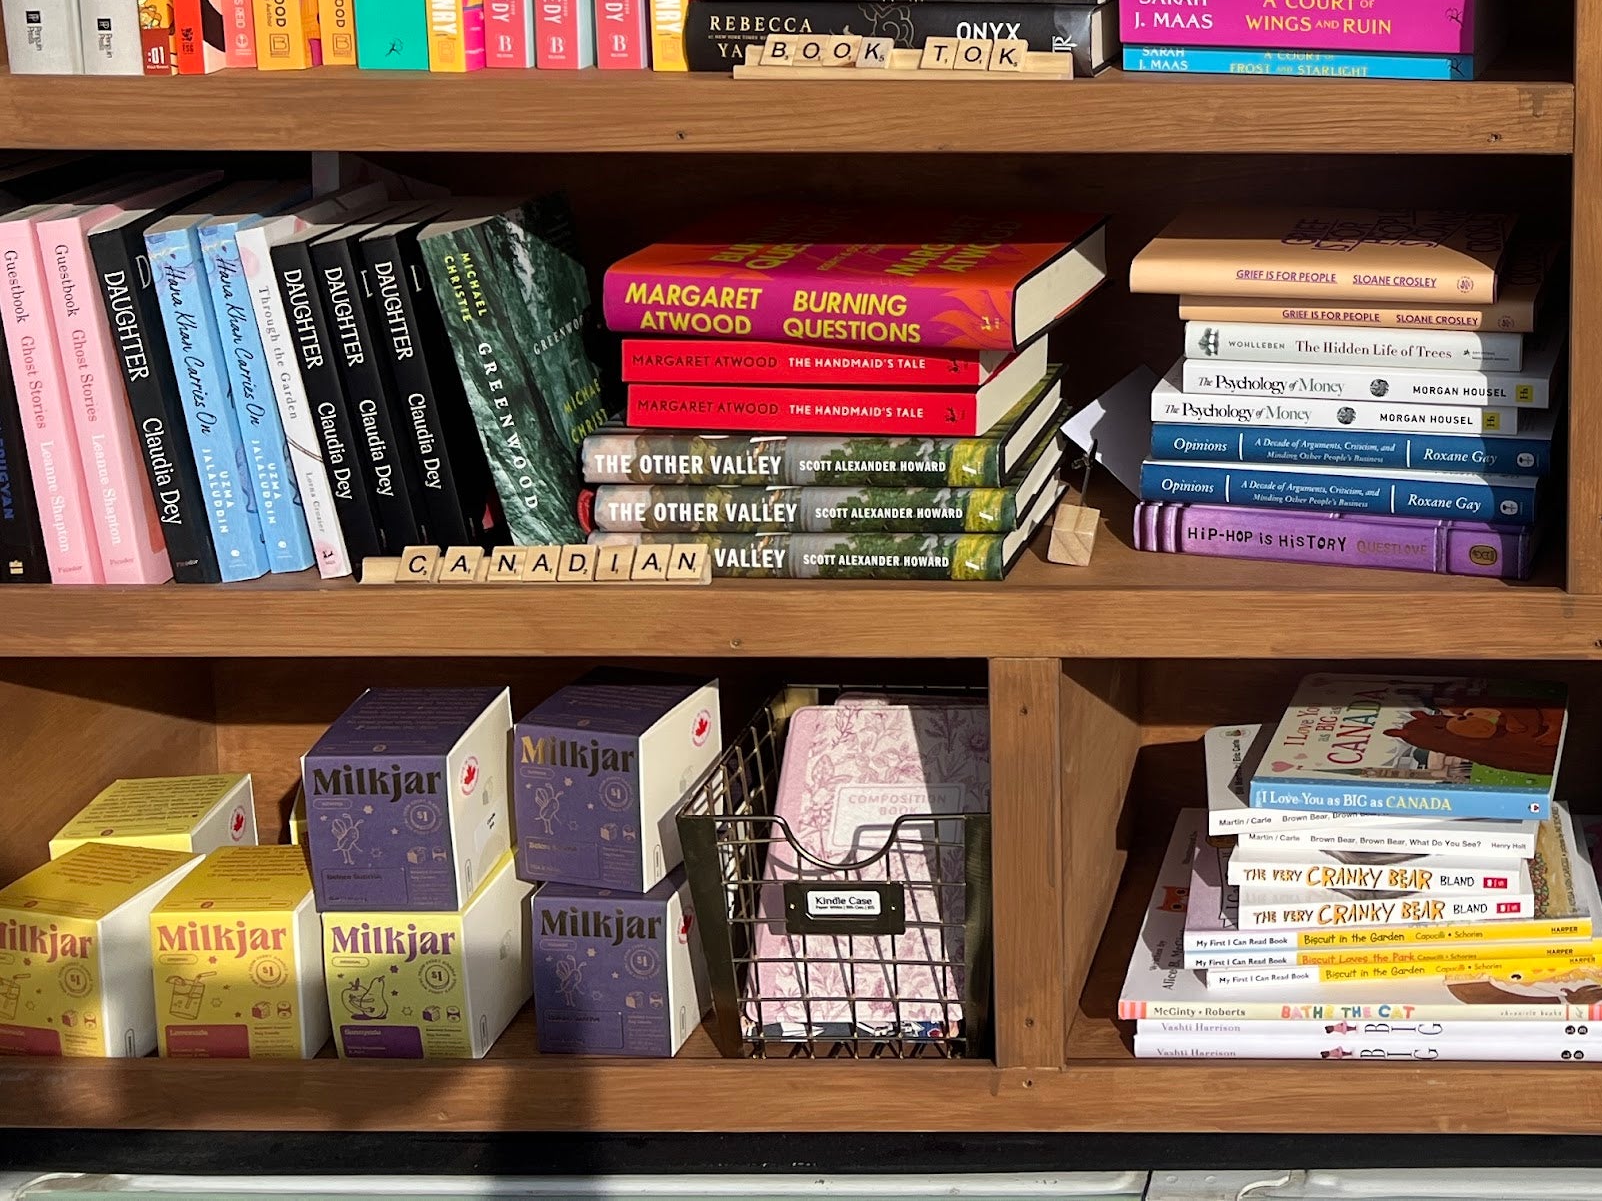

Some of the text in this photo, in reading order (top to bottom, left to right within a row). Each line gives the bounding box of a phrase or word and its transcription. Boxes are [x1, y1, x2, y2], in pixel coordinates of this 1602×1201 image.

[771, 39, 1018, 68] BOOK TOK
[1235, 269, 1437, 289] GRIEF IS FOR PEOPLE SLOANE CROSLEY
[625, 282, 907, 316] MARGARET BURNING
[640, 312, 921, 343] ATWOOD QUESTIONS
[1228, 340, 1452, 359] WOHLLEBEN The Hidden Life of Trees
[788, 357, 926, 370] THE HANDMAID'S TALE
[1215, 376, 1507, 398] Psychology Money MORGAN HOUSEL
[104, 271, 183, 526] DAUGHTER Claudia Dey
[478, 342, 538, 510] GREENWOOD
[1173, 438, 1498, 467] Opinions Roxane Gay
[594, 454, 946, 475] THE OTHER VALLEY SCOTT ALEXANDER HOWARD
[408, 553, 698, 574] CANADIAN
[520, 735, 635, 777] Milkjar
[1269, 792, 1452, 811] Love You as BIG as CANADA
[1311, 835, 1481, 848] Brown Bear, Brown Bear, What Do You See?
[1243, 866, 1475, 889] THE VERY CRANKY BEAR BLAND
[156, 922, 286, 959] Milkjar
[1304, 932, 1405, 945] Biscuit in the Garden
